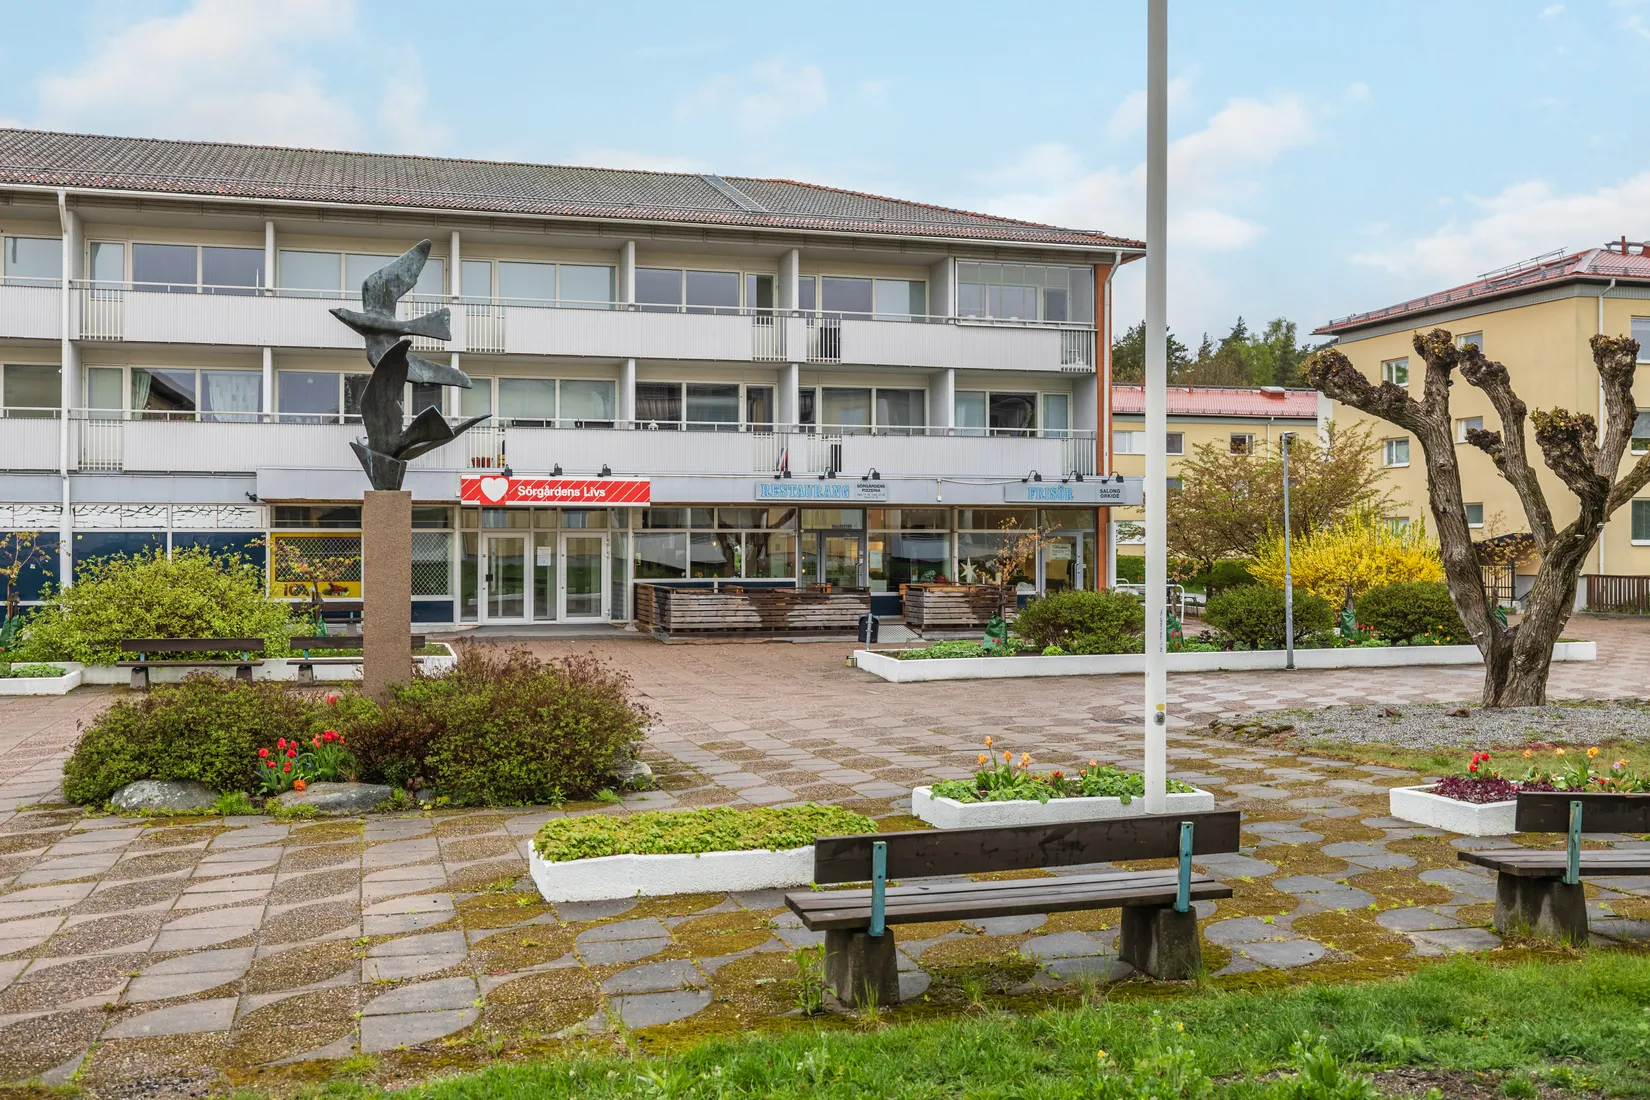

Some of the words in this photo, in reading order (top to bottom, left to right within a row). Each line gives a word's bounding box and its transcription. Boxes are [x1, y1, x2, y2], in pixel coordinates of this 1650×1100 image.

[518, 486, 580, 498] Sörgårdens
[584, 486, 606, 497] Livs
[761, 484, 850, 498] RESTAURANG
[1028, 485, 1074, 500] FRISÖR
[284, 584, 310, 596] ICA
